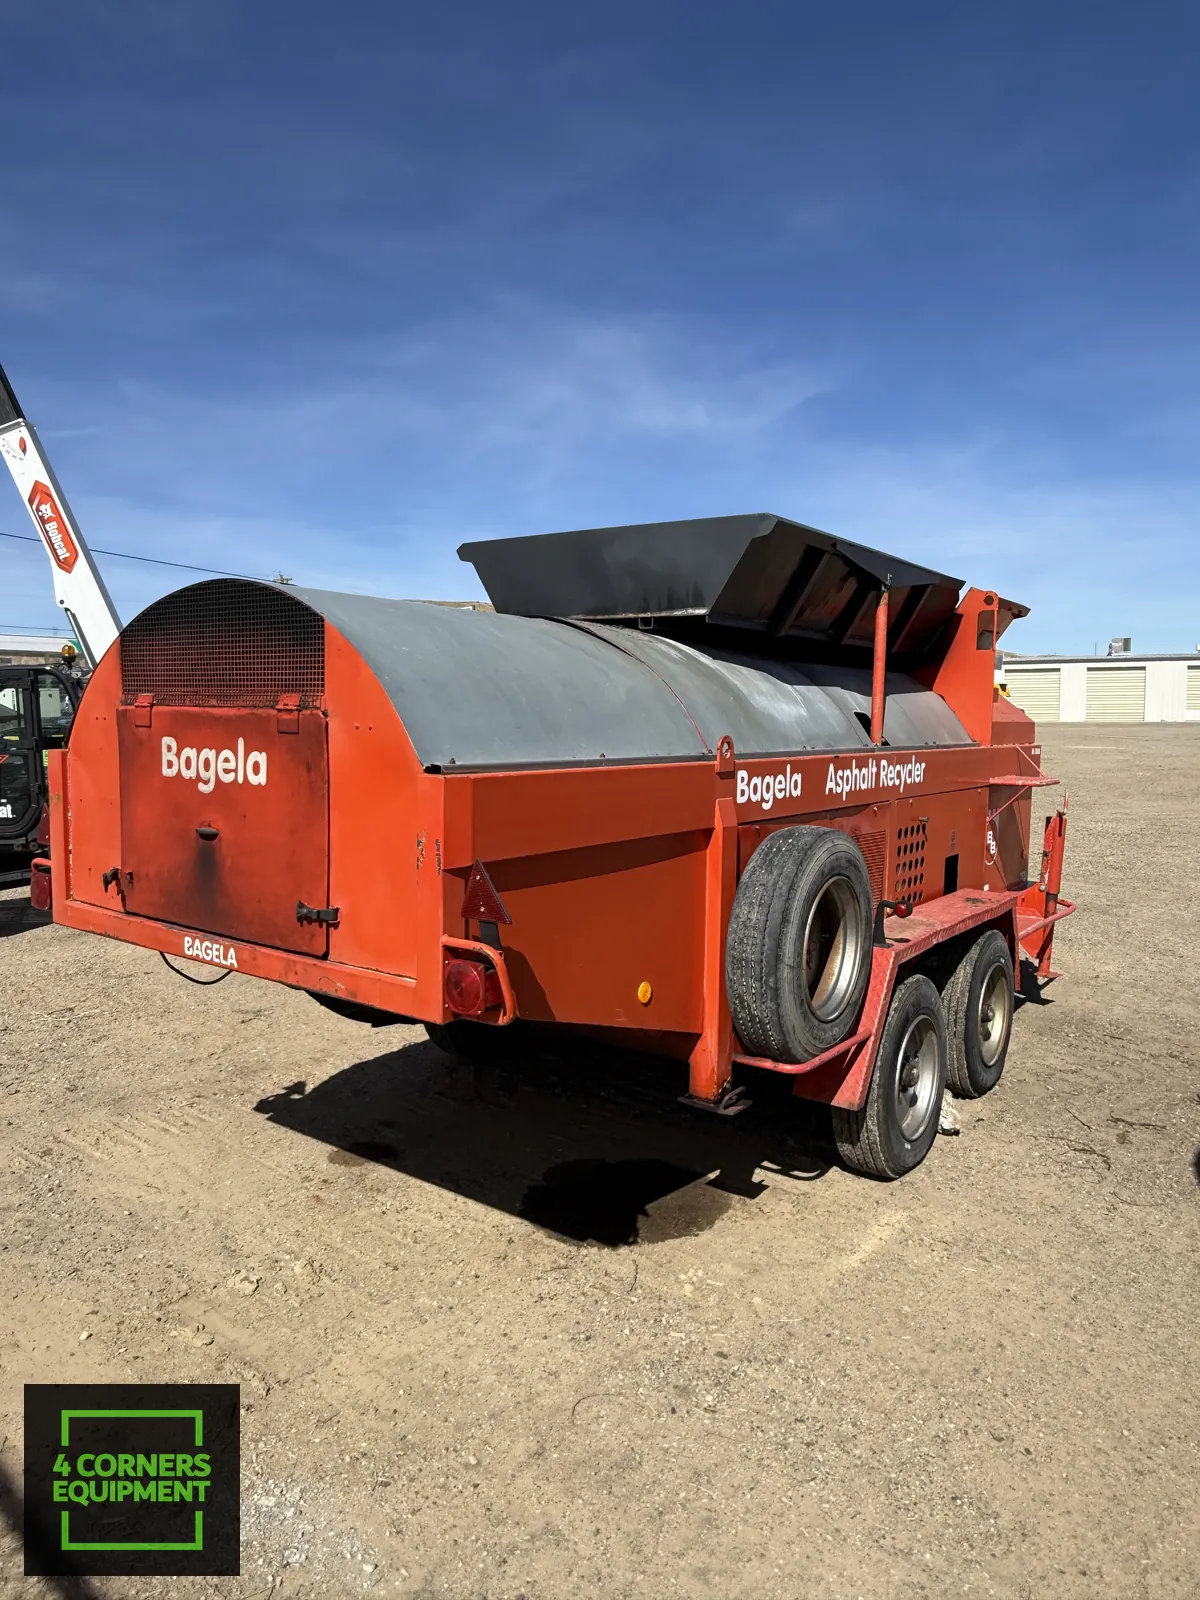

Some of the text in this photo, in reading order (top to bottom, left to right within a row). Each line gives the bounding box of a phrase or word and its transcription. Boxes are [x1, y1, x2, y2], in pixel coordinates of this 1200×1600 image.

[161, 736, 268, 794] Bagela
[736, 763, 802, 811] Bagela
[825, 754, 926, 801] Asphalt Recycler
[184, 936, 238, 969] BAGELA
